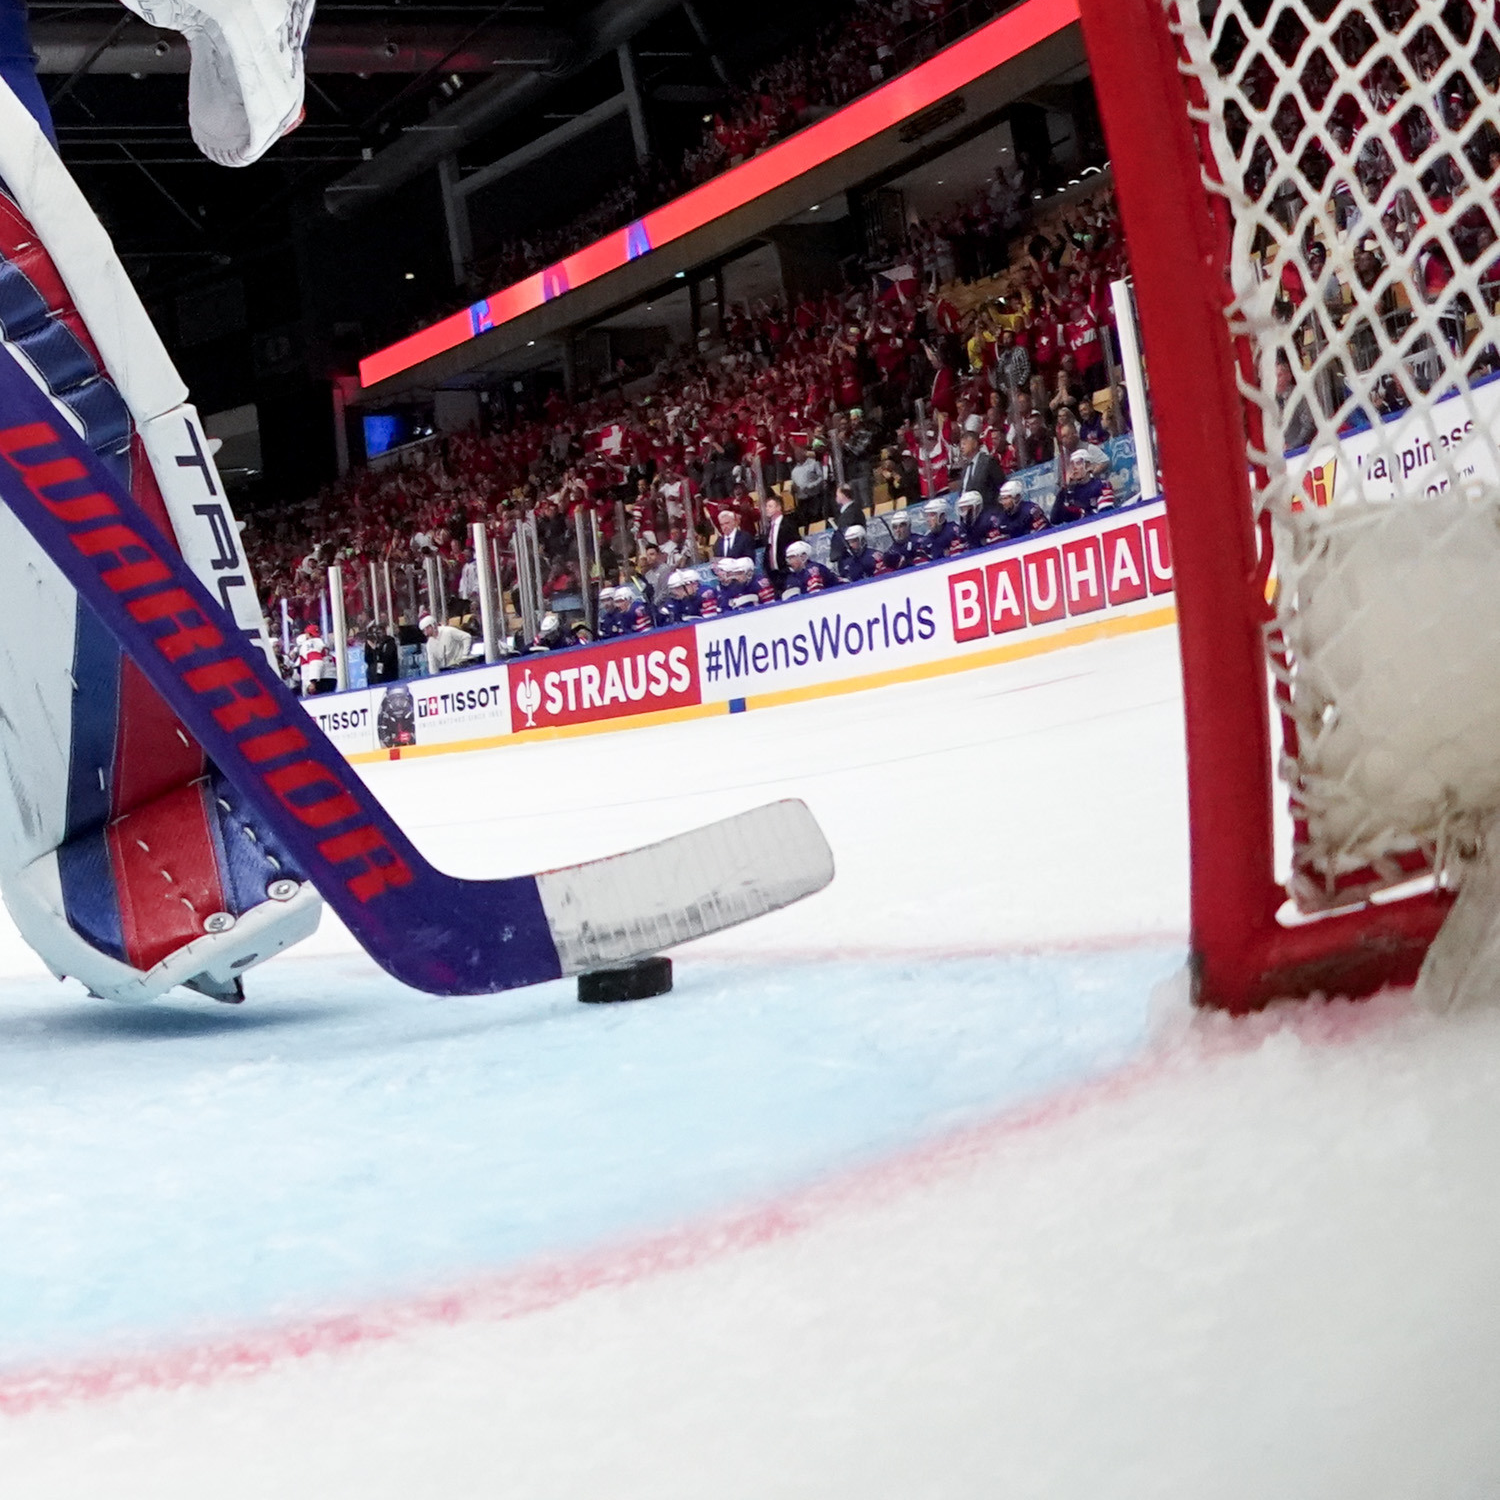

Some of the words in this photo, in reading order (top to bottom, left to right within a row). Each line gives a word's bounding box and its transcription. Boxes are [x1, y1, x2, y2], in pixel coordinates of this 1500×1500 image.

[705, 598, 936, 682] #MensWorlds
[438, 684, 500, 714] TISSOT
[544, 646, 692, 711] STRAUSS
[319, 707, 368, 731] TISSOT
